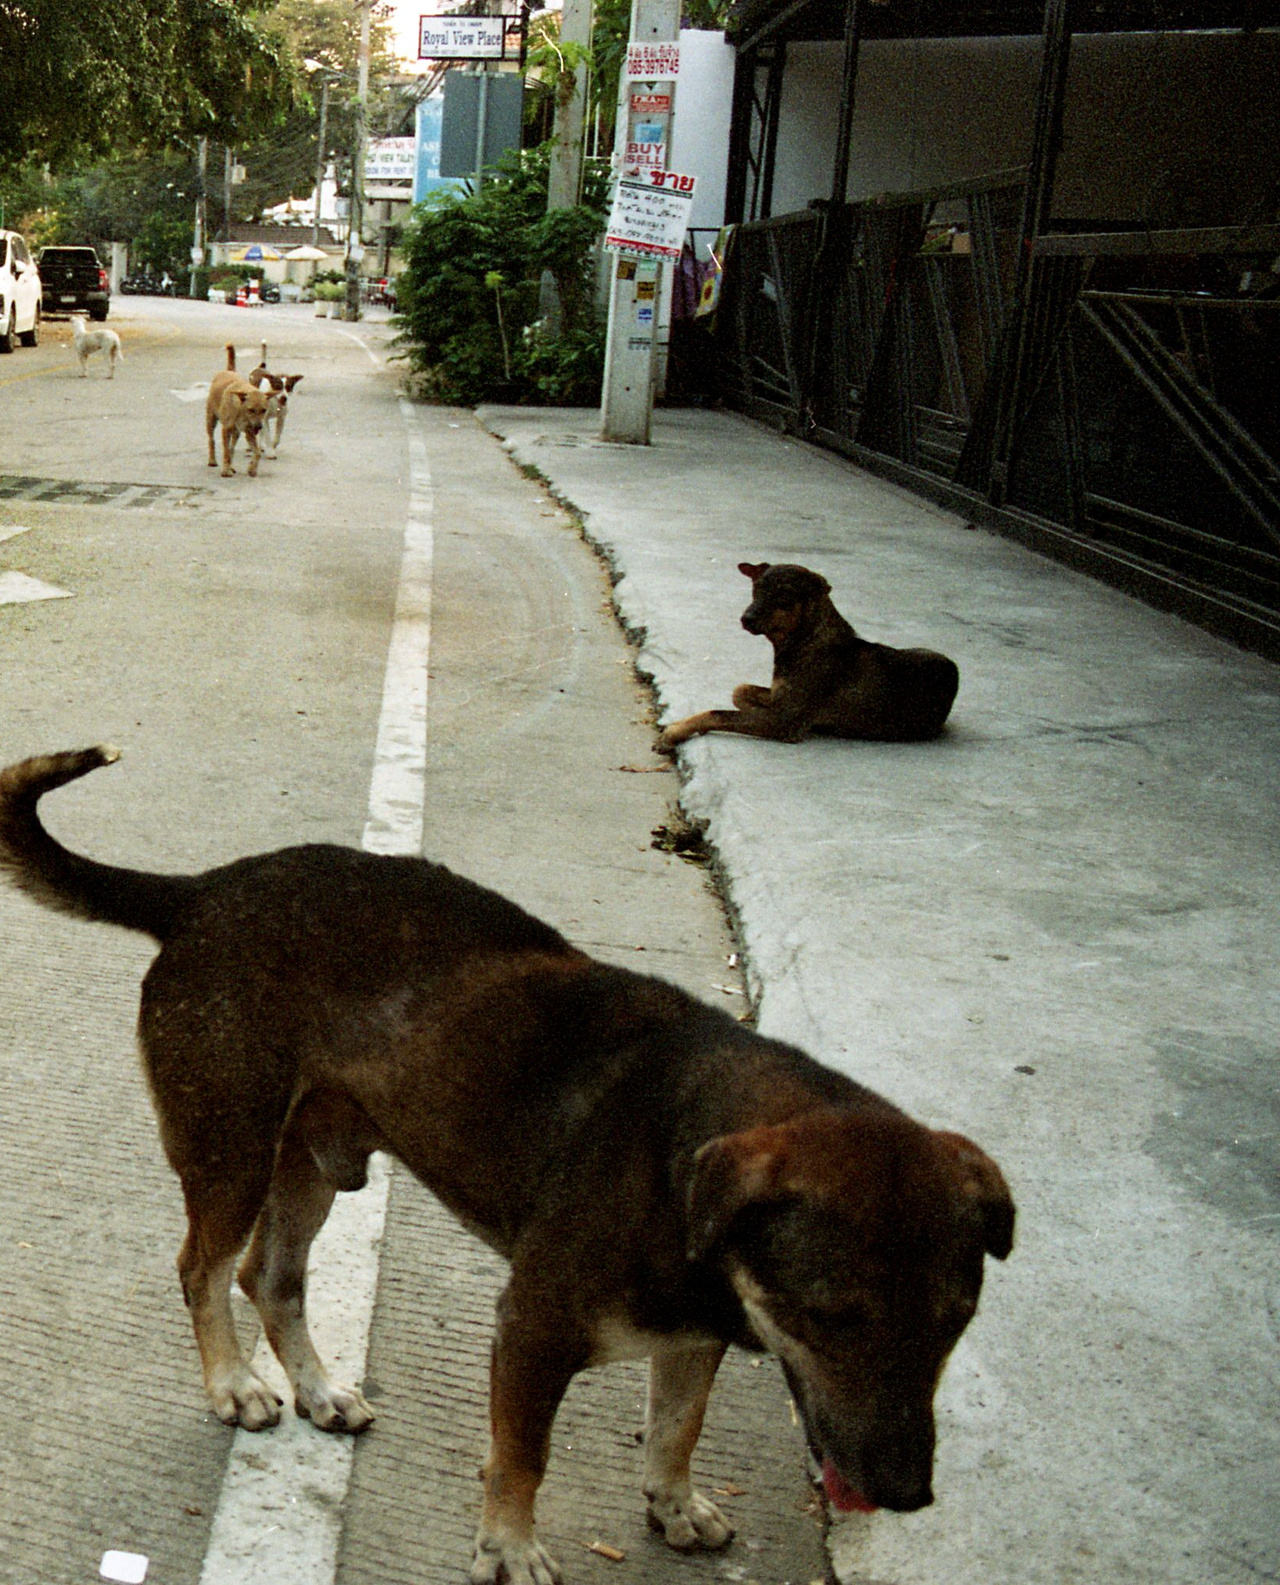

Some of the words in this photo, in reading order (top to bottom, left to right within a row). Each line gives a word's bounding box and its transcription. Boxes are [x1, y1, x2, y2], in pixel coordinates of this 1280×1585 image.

[423, 30, 449, 49] Royal
[453, 30, 475, 46] View
[477, 30, 502, 46] Place
[628, 143, 663, 154] BUY
[626, 155, 662, 165] SELL
[650, 170, 694, 191] ขาย
